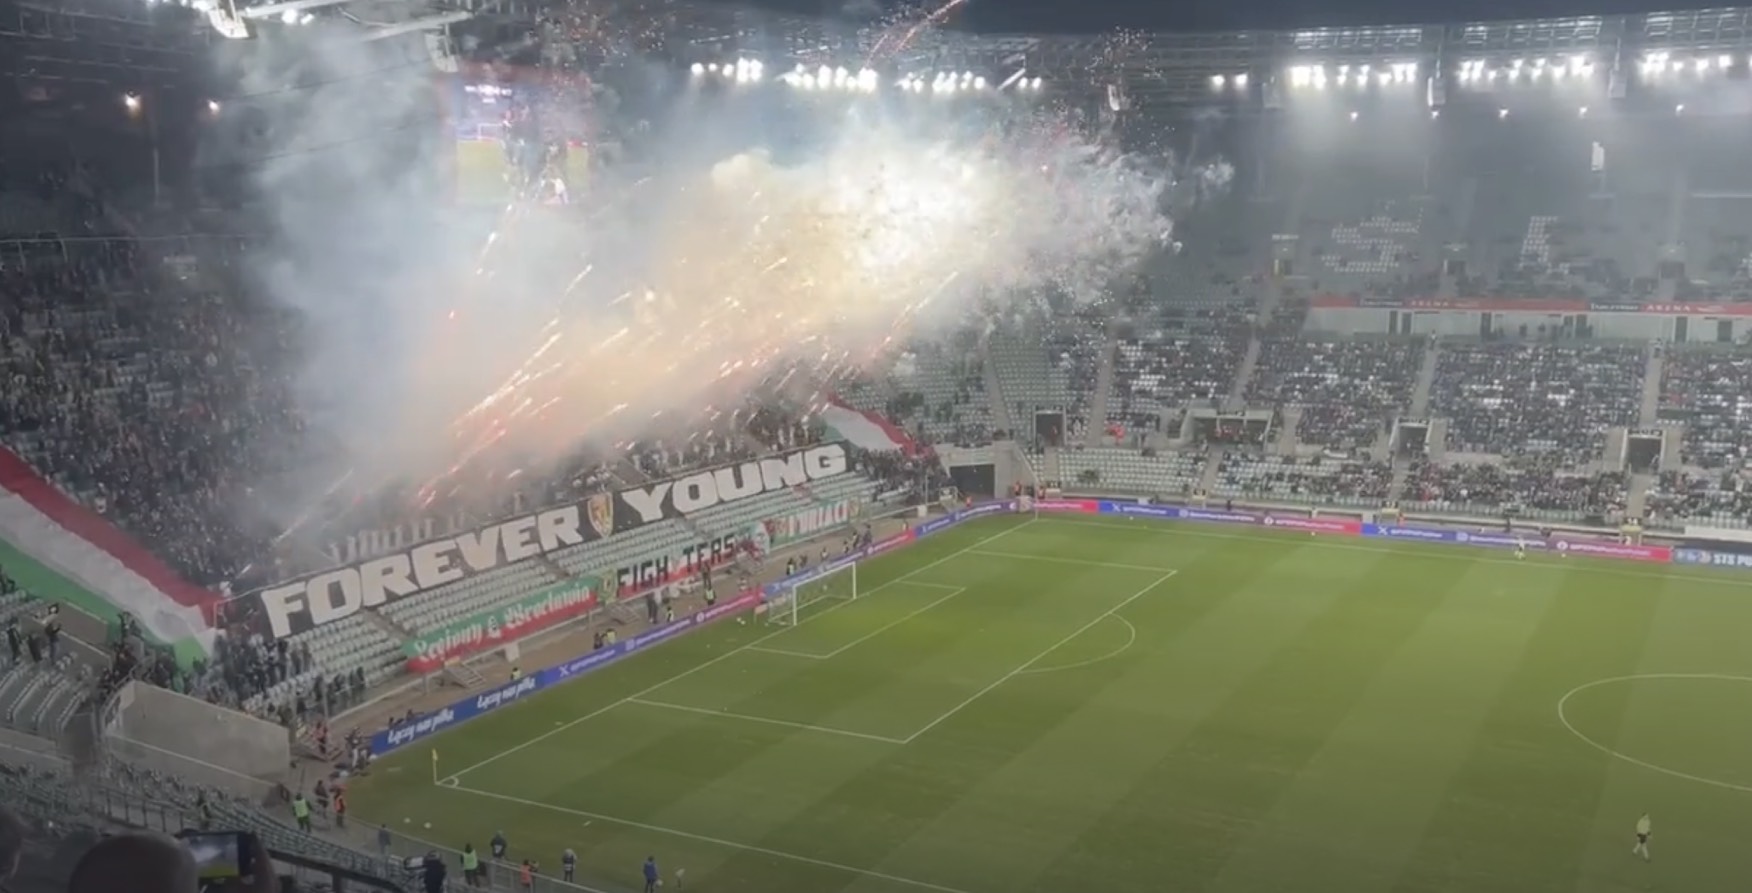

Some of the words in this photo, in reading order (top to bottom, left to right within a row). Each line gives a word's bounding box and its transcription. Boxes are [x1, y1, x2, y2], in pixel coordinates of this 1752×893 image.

[260, 505, 584, 638] FOREVER
[621, 443, 847, 523] YOUNG
[1713, 553, 1736, 566] STS
